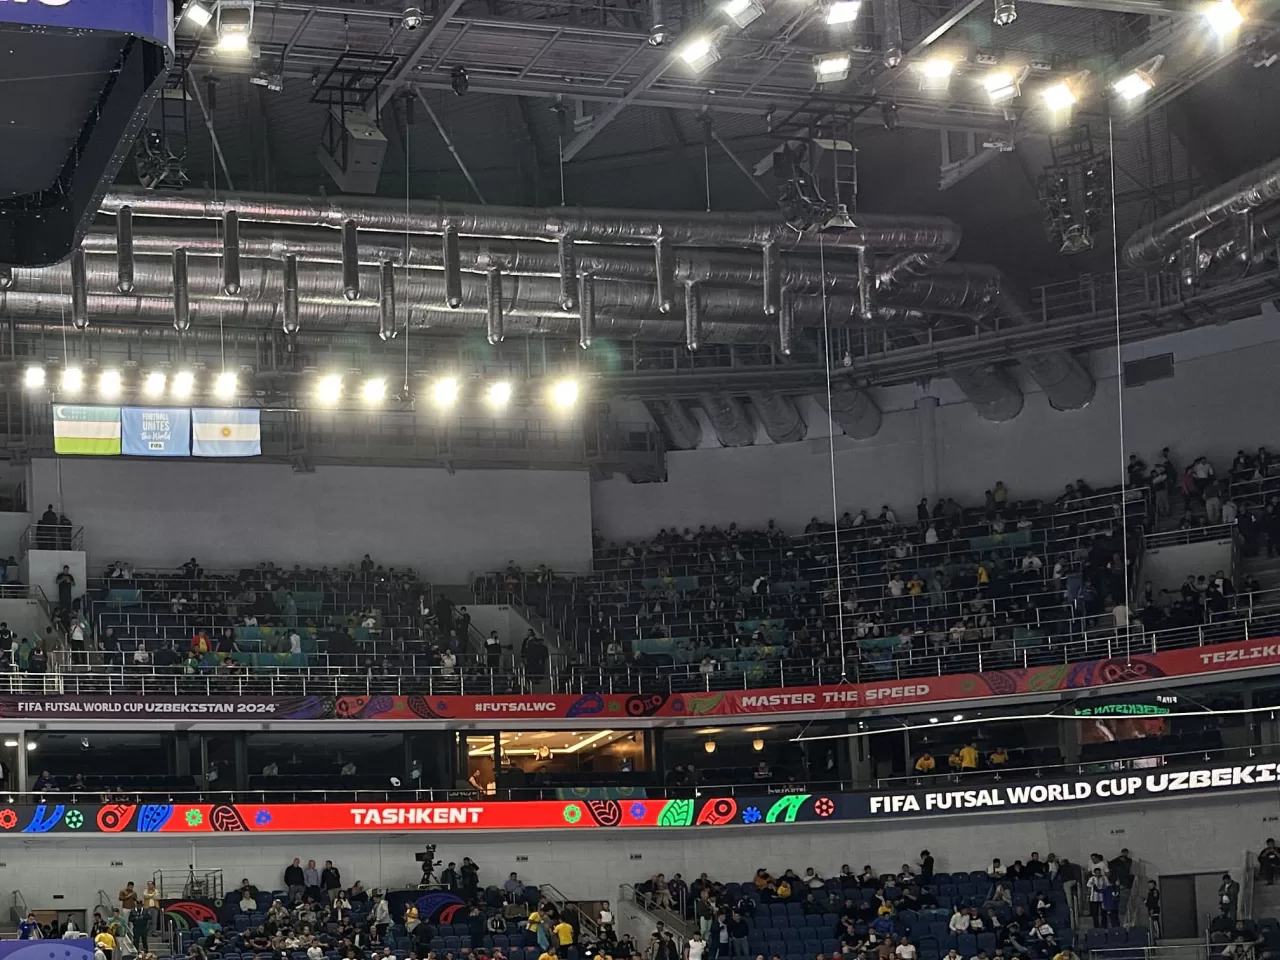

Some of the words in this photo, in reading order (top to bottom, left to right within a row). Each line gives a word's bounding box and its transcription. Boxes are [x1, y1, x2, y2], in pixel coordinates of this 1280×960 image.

[142, 420, 170, 431] UNITES
[742, 692, 816, 707] MASTER
[822, 691, 858, 703] THE
[866, 684, 930, 701] SPEED
[18, 702, 42, 712] FIFA
[45, 702, 83, 712] FUTSAL
[83, 702, 121, 712] WORLD
[123, 702, 144, 712] CUP
[145, 702, 234, 713] UZBEKISTAN
[475, 702, 556, 712] #FUTSALWC
[870, 795, 921, 814] FIFA
[924, 788, 1005, 810] FUTSAL
[1007, 781, 1092, 804] WORLD
[1097, 776, 1142, 797] CUP
[350, 807, 484, 825] TASHKENT
